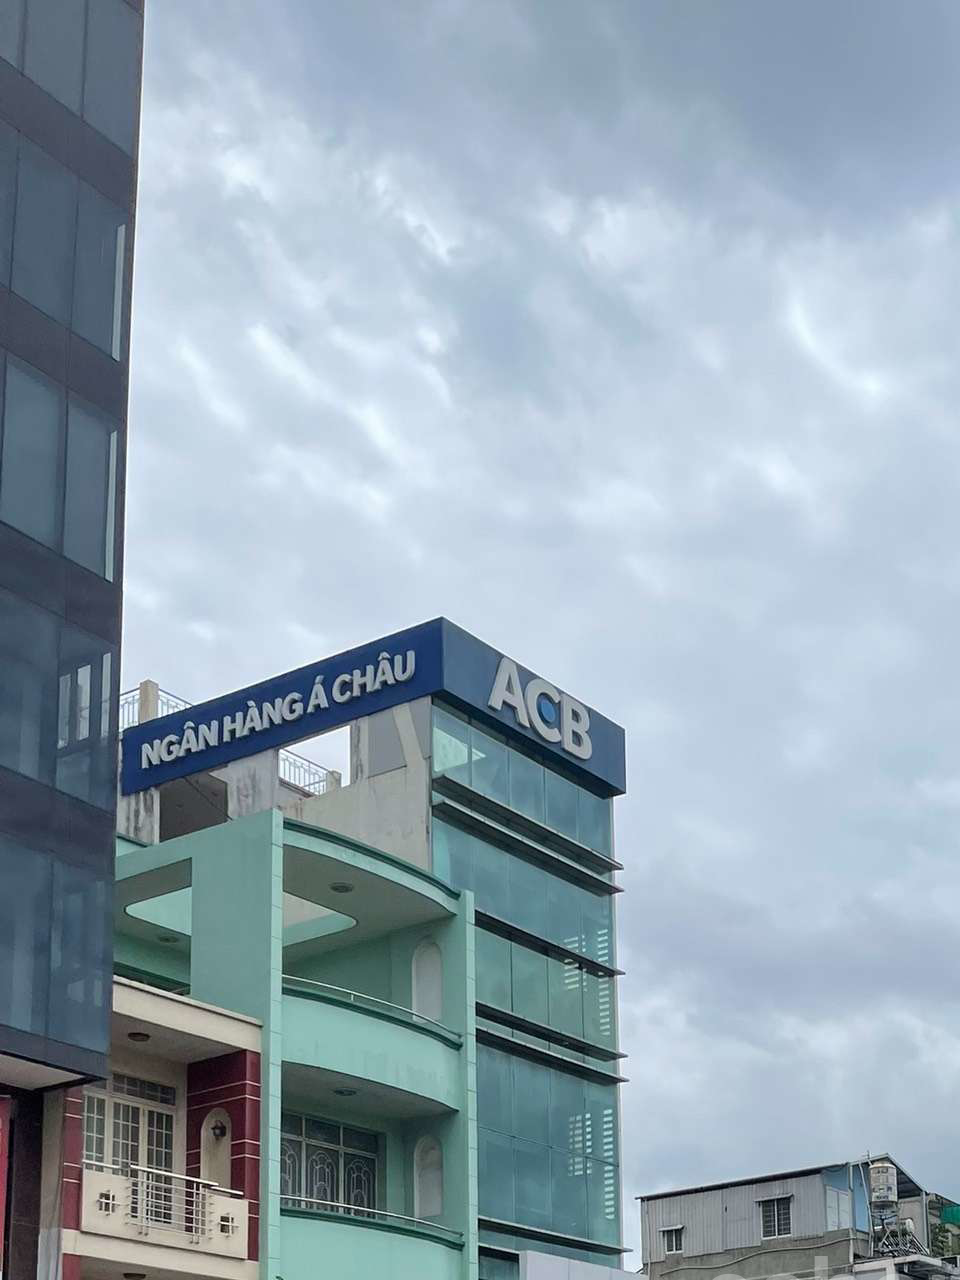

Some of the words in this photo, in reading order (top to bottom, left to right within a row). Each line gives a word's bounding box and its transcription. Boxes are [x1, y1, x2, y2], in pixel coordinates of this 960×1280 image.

[141, 721, 219, 769] NGÂN
[223, 692, 302, 744] HÀNG
[306, 676, 328, 715] Á
[331, 650, 416, 705] CHÂU
[488, 657, 593, 761] ACB
